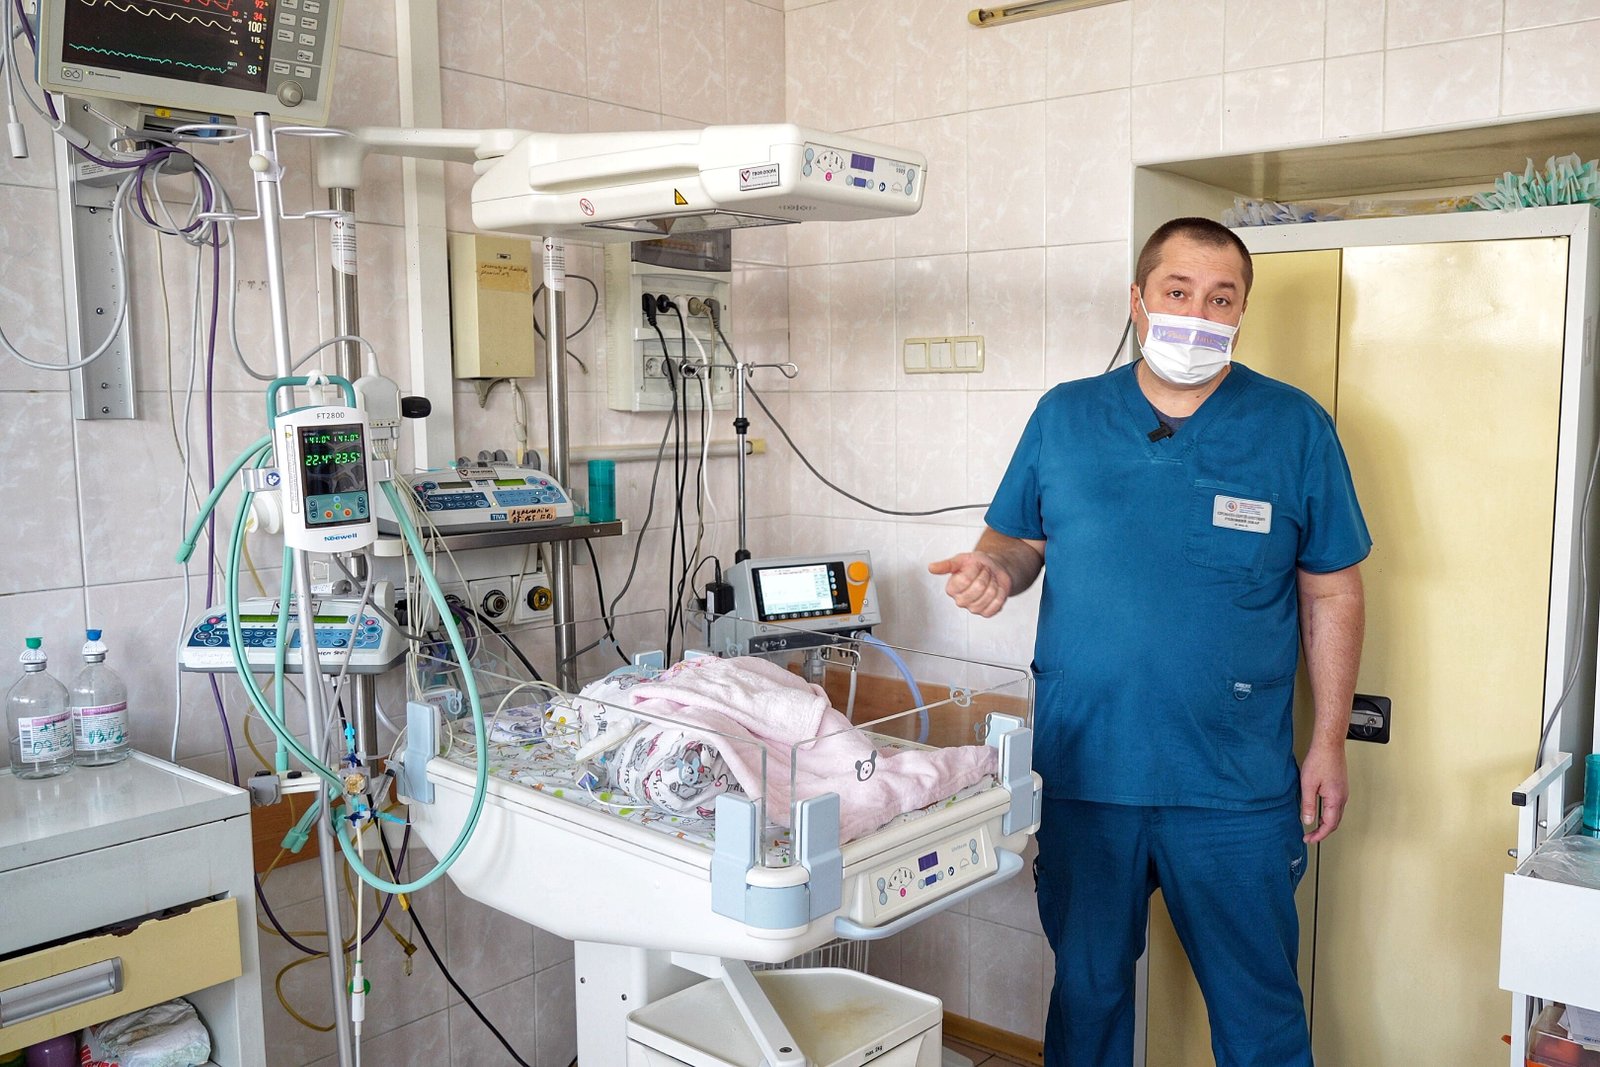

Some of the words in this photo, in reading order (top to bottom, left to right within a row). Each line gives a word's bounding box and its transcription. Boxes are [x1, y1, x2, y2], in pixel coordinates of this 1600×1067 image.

[253, 12, 263, 22] 34
[247, 20, 262, 33] 100
[250, 36, 261, 44] 115
[247, 64, 257, 75] 33
